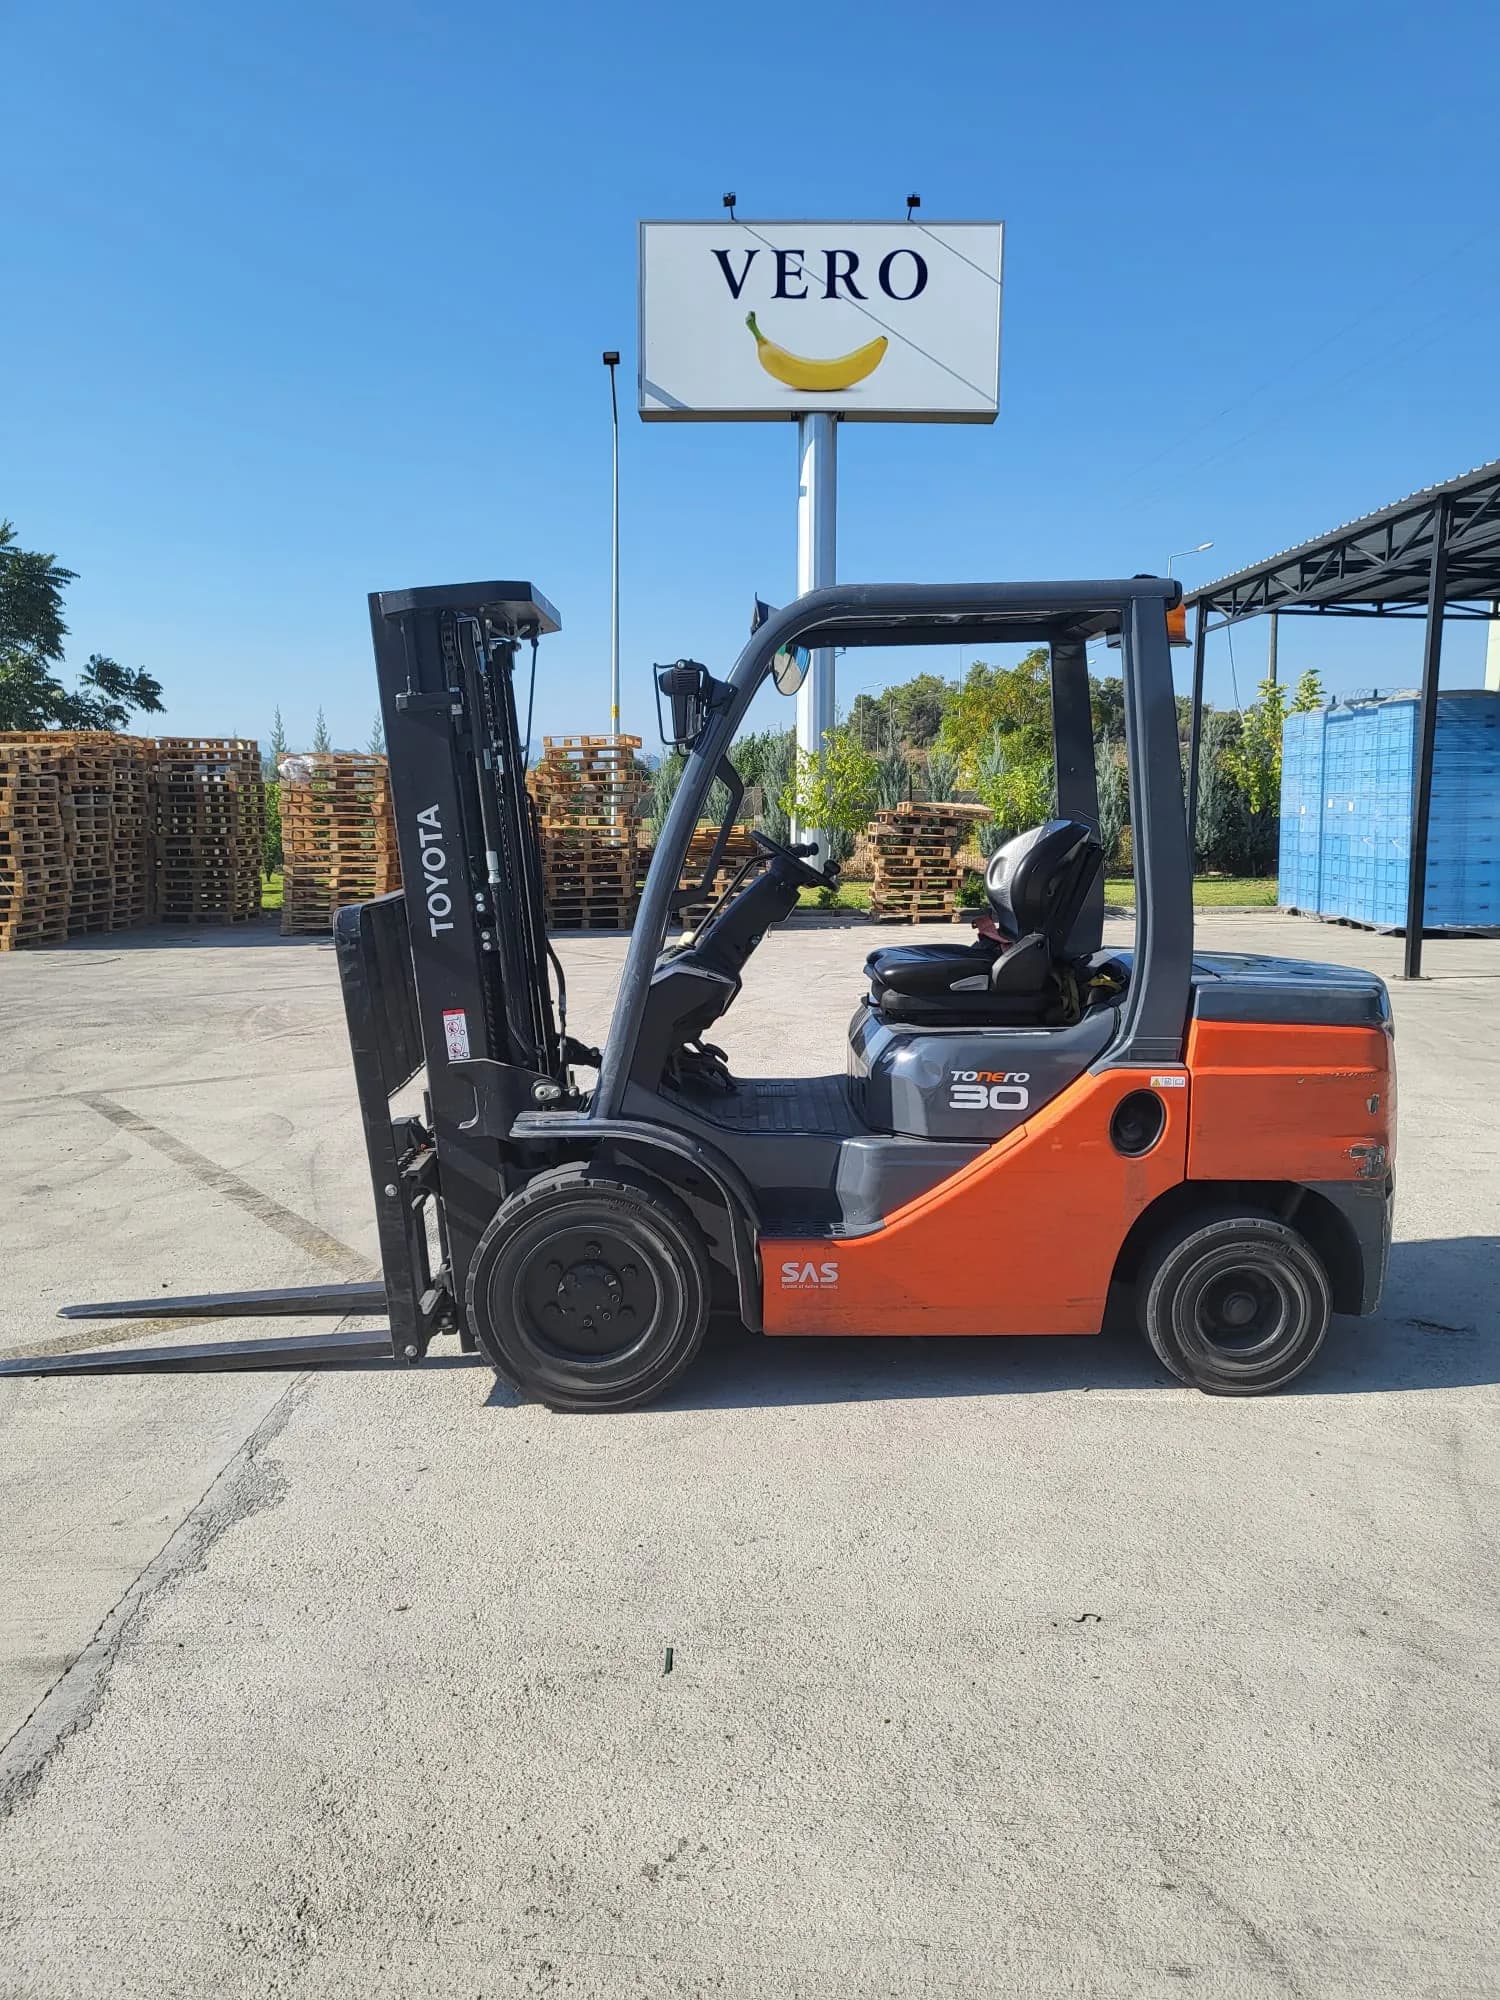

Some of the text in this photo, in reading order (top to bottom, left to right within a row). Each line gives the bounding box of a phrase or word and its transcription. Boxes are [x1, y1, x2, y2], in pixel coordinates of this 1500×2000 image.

[711, 248, 928, 301] VERO
[416, 803, 454, 938] TOYOTA
[949, 1084, 1029, 1111] 30
[781, 1262, 839, 1283] SAS
